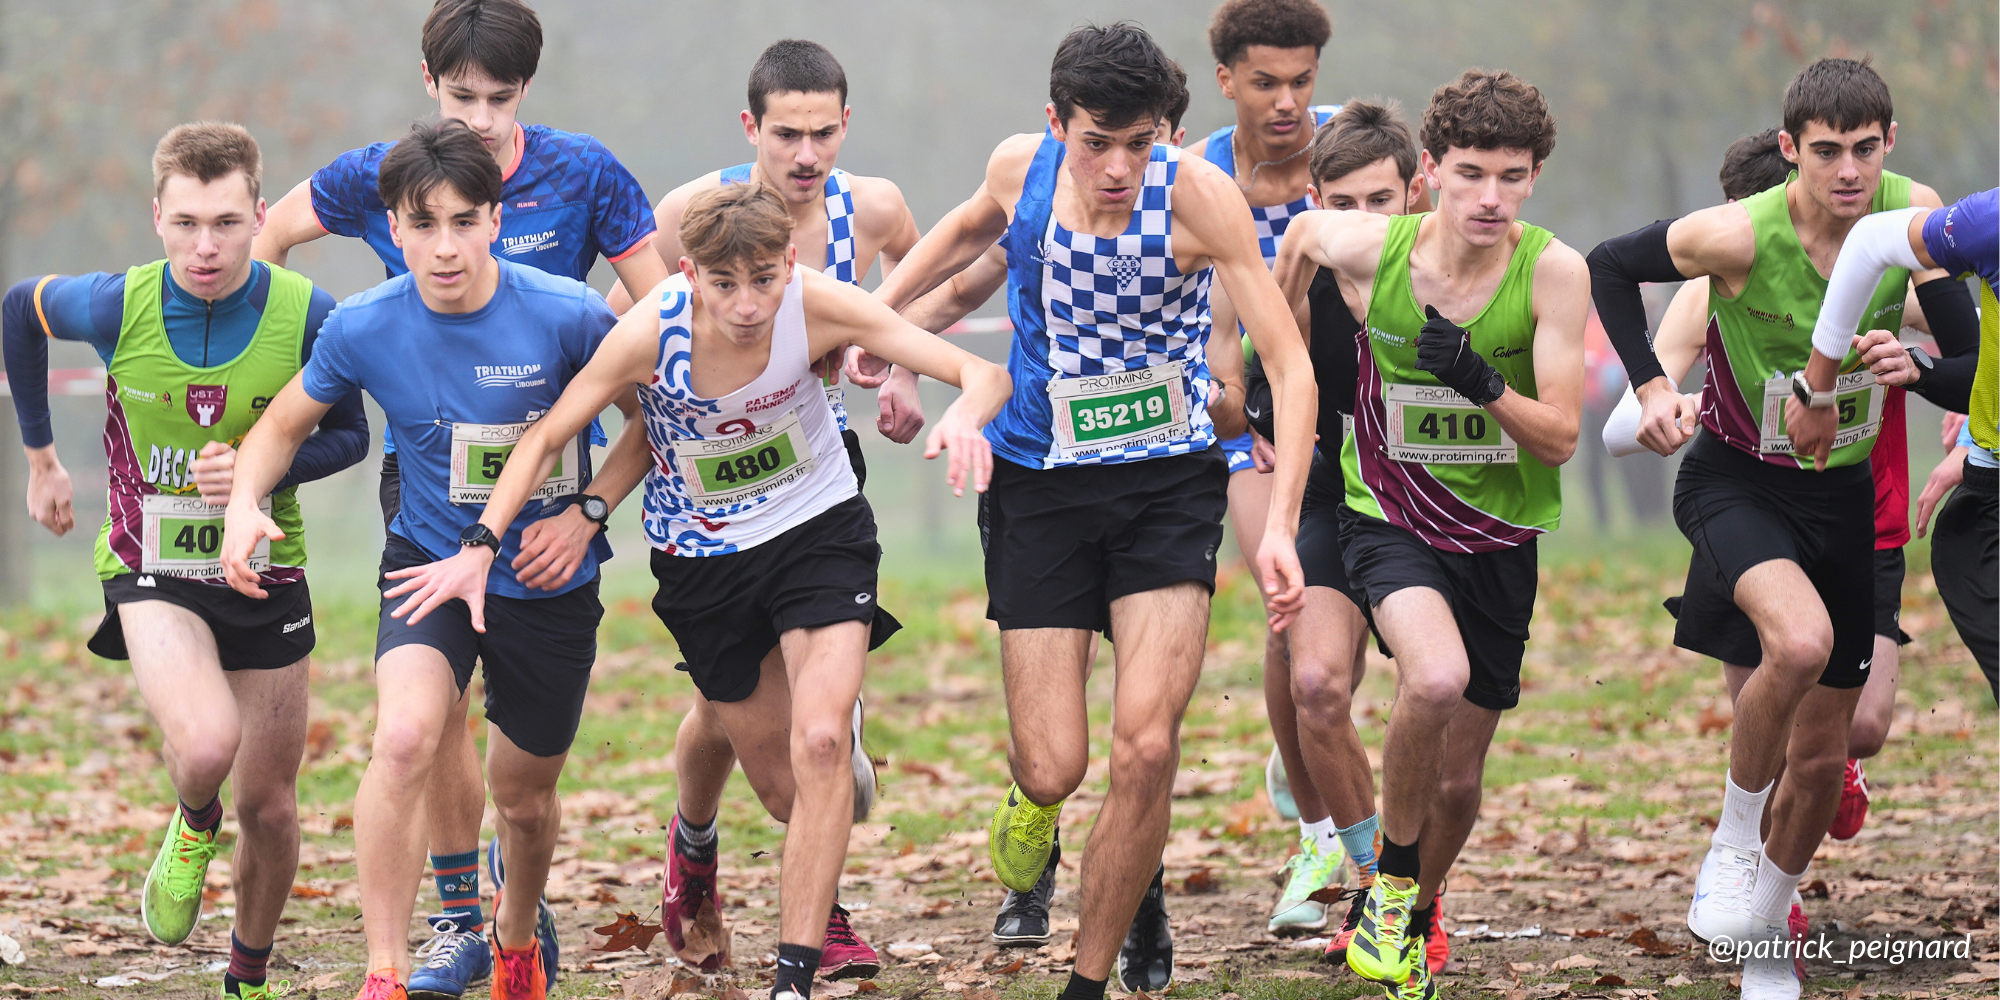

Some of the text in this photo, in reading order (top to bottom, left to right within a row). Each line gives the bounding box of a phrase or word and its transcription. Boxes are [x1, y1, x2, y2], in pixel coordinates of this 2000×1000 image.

[502, 230, 556, 249] TRIATHLON
[1371, 326, 1406, 344] RUNNING
[474, 363, 541, 378] TRIATHLON
[1078, 369, 1153, 390] PROTIMING
[123, 385, 156, 400] RUNNING
[515, 378, 547, 388] LIBOURNE
[1415, 387, 1467, 399] PROTIM
[746, 389, 796, 414] RUNNERS
[1077, 396, 1164, 432] 35219
[481, 424, 534, 437] PROTIM
[1418, 412, 1486, 440] 410
[701, 425, 773, 450] PROTIMING
[714, 446, 781, 484] 480
[1398, 450, 1507, 463] www.protiming.fr
[702, 465, 806, 506] www.protiming.fr
[174, 524, 225, 554] 40
[282, 613, 311, 634] Santini
